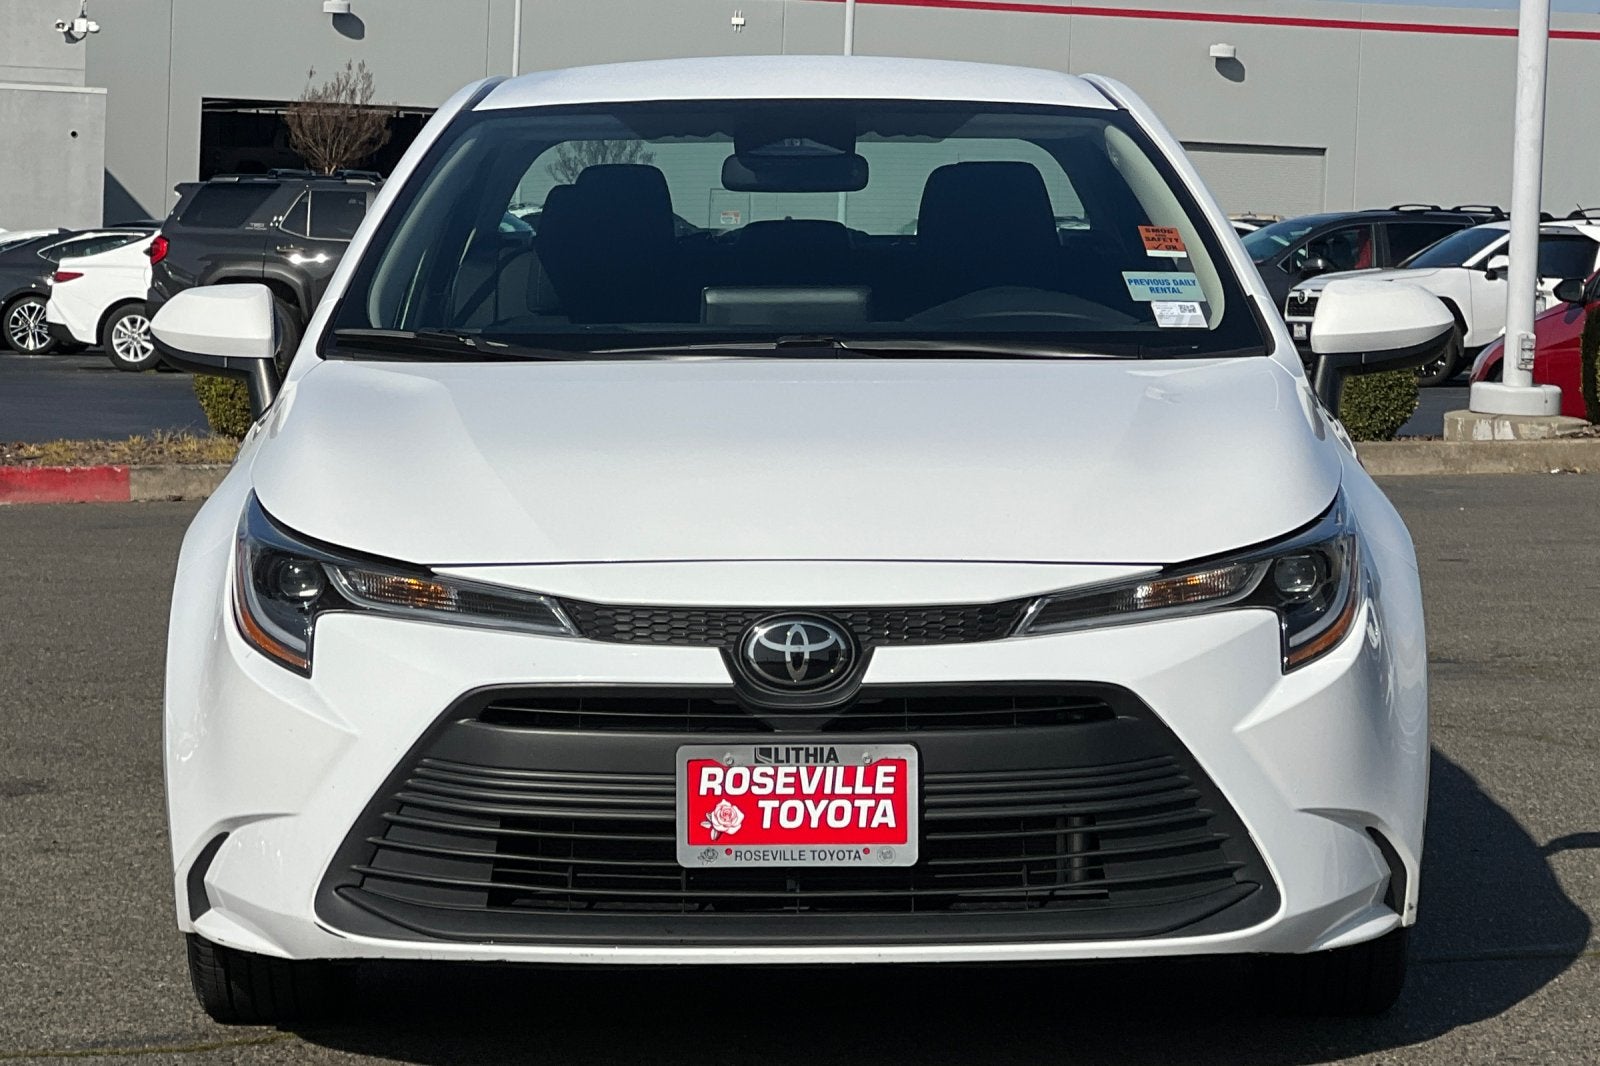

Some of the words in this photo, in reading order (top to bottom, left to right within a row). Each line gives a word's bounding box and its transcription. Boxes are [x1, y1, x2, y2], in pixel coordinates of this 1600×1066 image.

[773, 747, 840, 764] LITHIA
[699, 765, 897, 796] ROSEVILLE
[758, 799, 897, 829] TOYOTA
[734, 849, 806, 862] ROSEVILLE
[811, 849, 862, 862] TOYOTA
